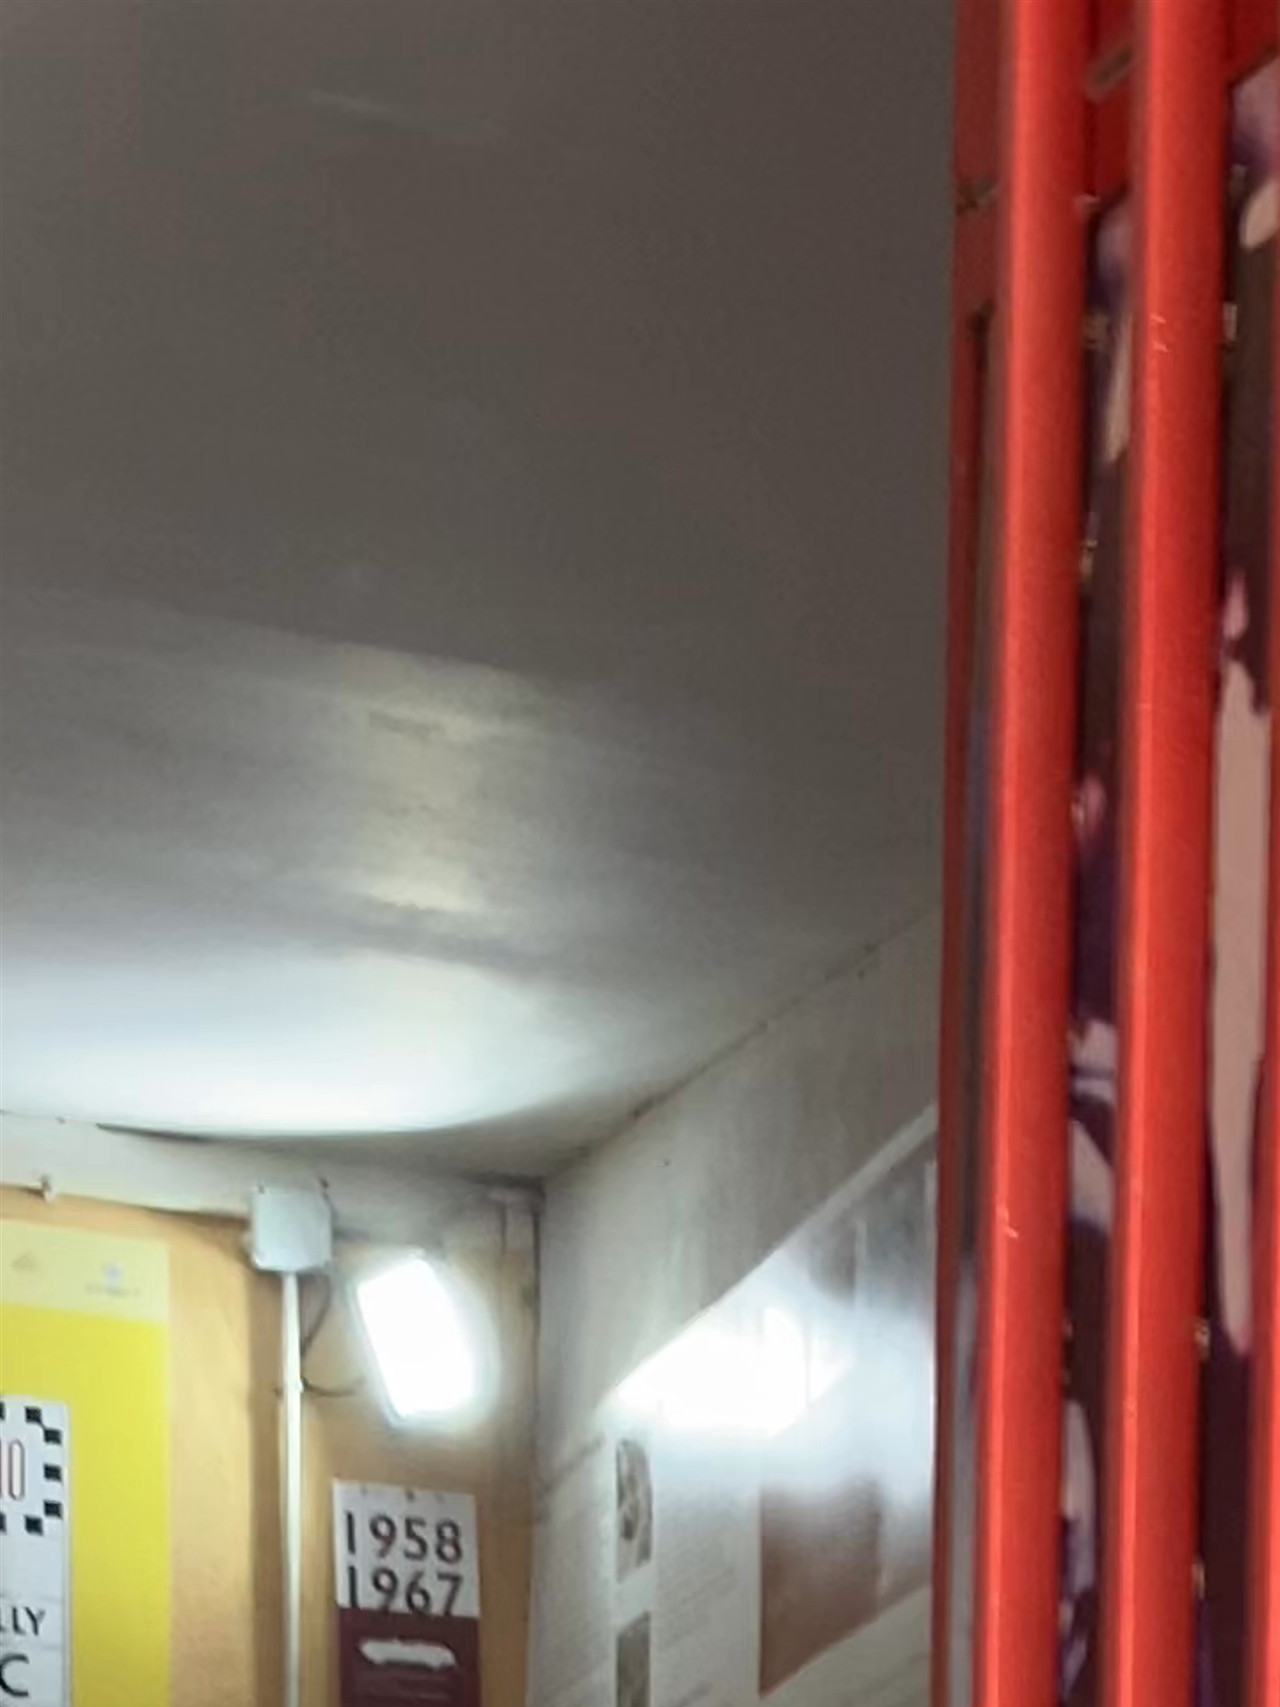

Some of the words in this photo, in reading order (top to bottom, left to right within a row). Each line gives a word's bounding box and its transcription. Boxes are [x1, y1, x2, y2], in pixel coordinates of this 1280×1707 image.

[344, 1510, 463, 1565] 1958
[347, 1565, 463, 1618] 1967
[0, 1606, 47, 1636] LY
